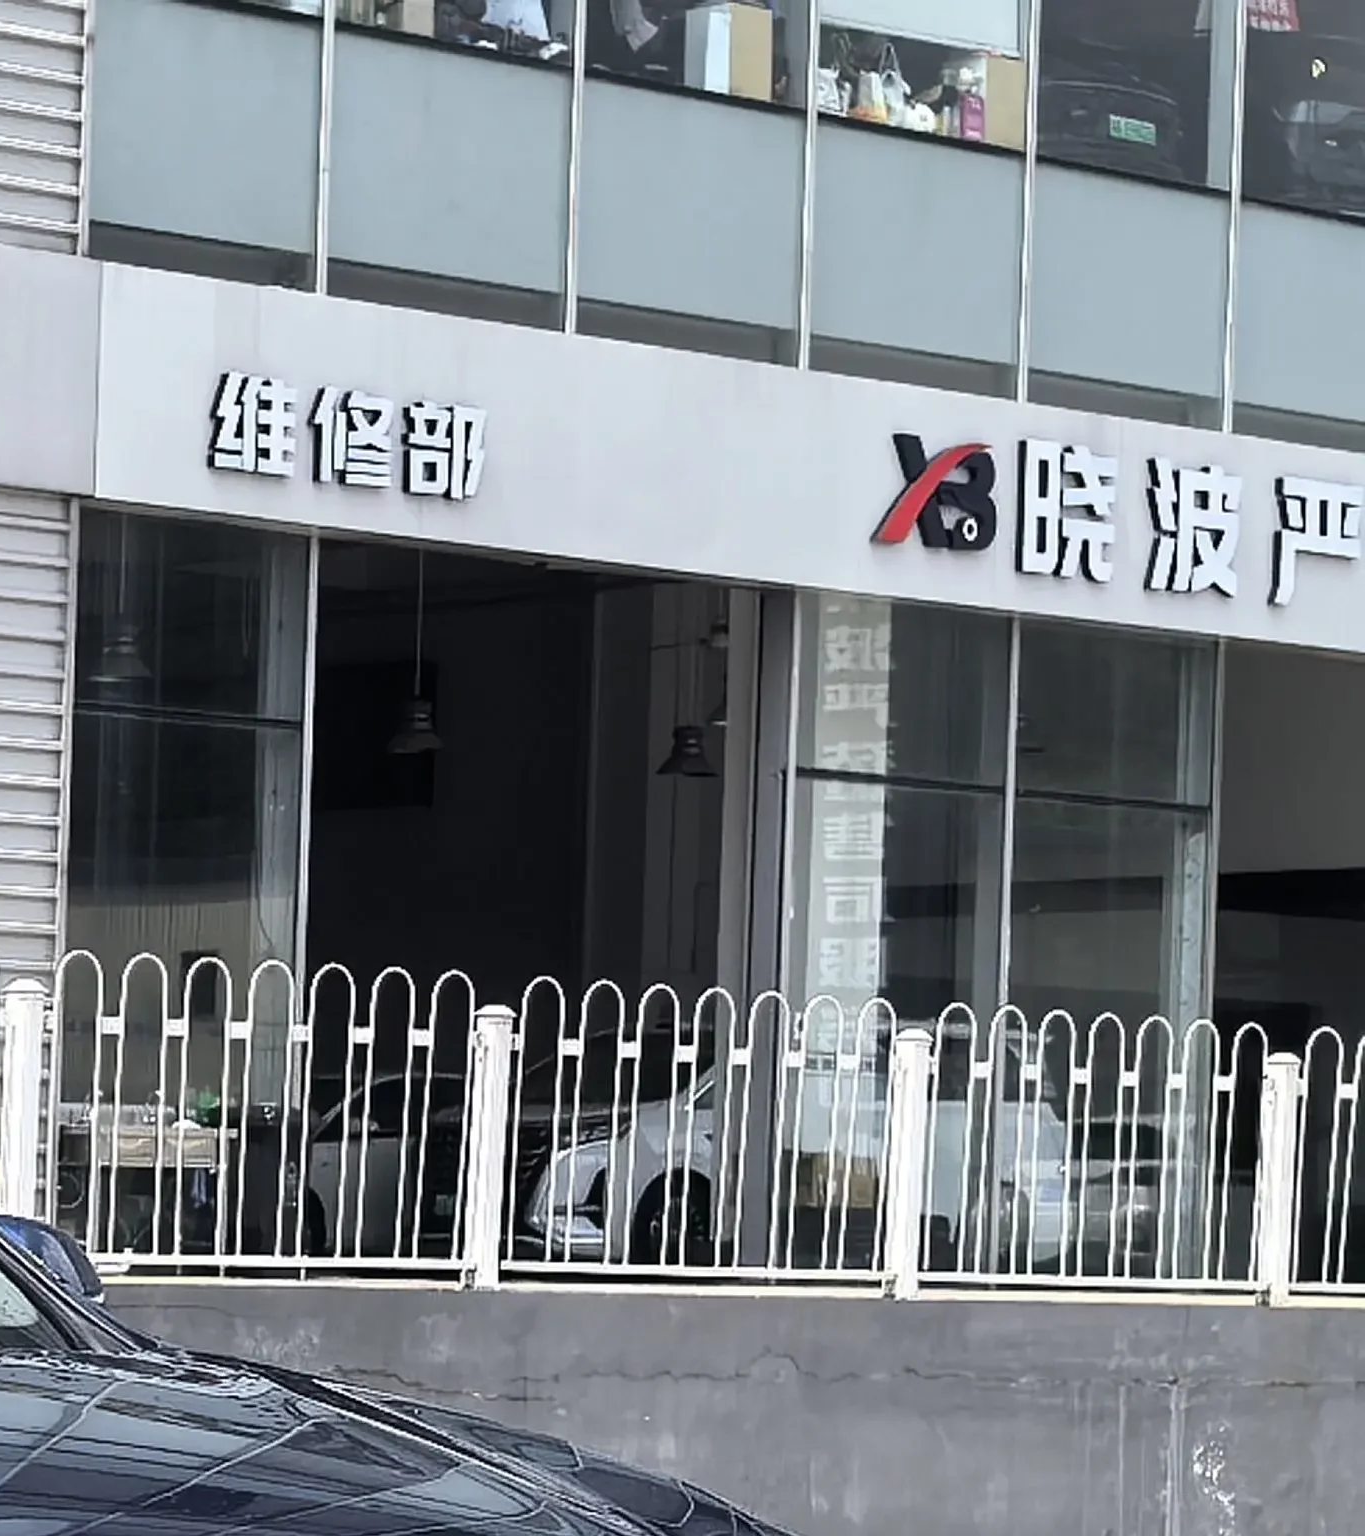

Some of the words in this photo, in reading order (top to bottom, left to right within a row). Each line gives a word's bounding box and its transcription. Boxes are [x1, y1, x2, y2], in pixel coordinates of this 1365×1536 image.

[207, 370, 487, 501] 维修部
[1015, 438, 1364, 606] 晓波严
